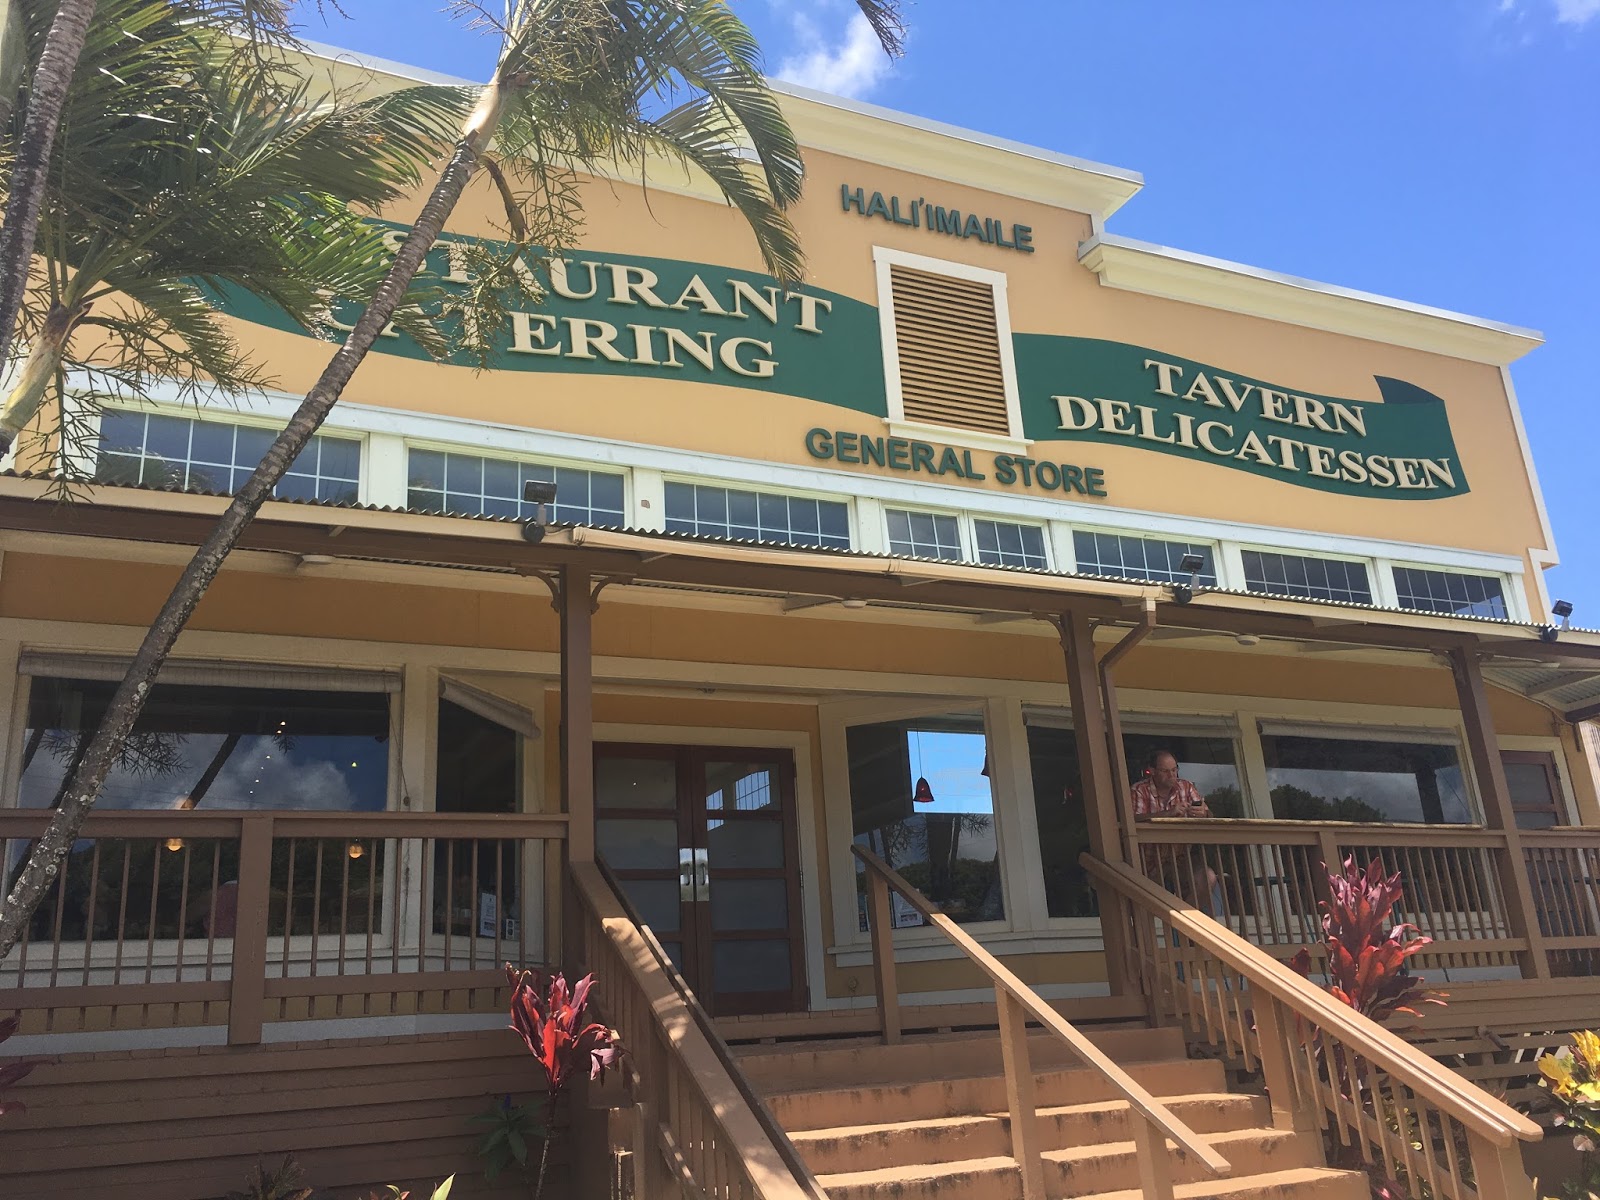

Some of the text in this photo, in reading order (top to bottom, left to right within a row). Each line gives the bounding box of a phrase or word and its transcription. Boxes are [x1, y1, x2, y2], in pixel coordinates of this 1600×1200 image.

[303, 214, 832, 335] STAURANT
[1144, 358, 1367, 438] TAVERN
[805, 428, 1108, 497] GENERAL STORE
[1051, 395, 1457, 490] DELICATESSEN
